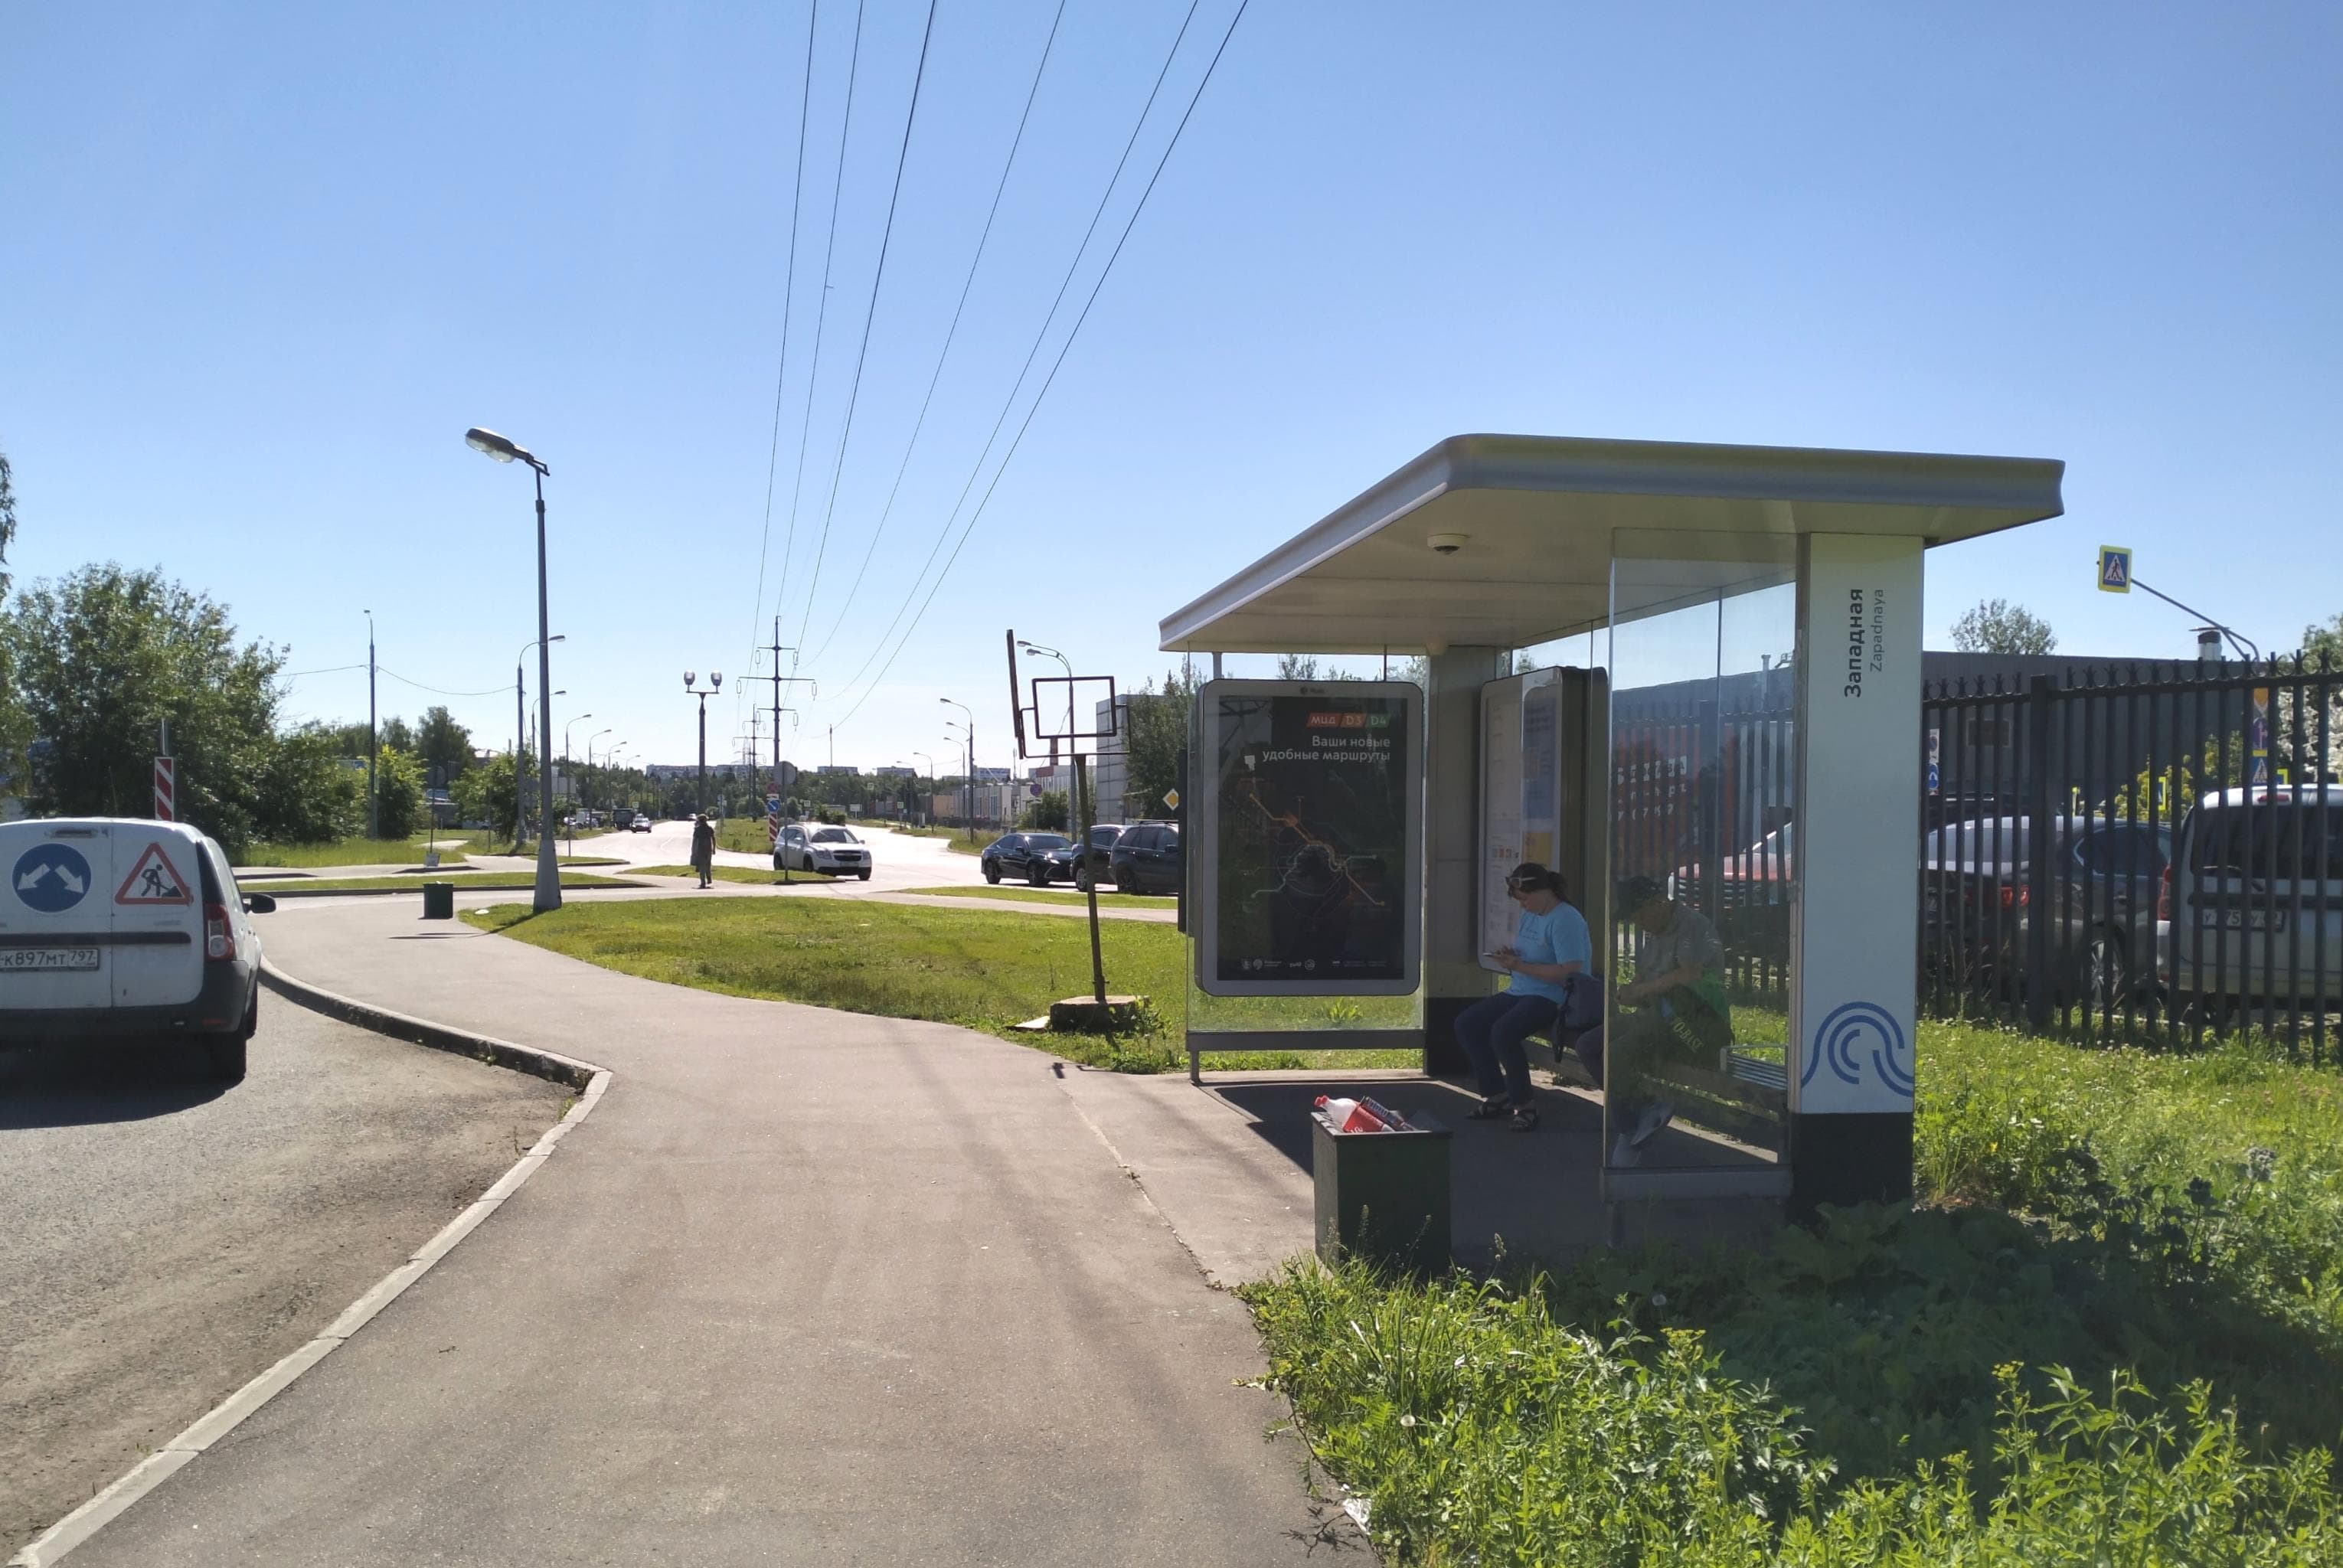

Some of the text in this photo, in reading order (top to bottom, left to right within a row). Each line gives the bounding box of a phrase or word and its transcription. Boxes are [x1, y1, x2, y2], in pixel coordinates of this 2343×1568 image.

[1870, 589, 1885, 672] Zapadnaya
[1844, 589, 1864, 697] Западная
[1371, 716, 1387, 725] D4
[1312, 735, 1390, 747] Ваши новые
[1263, 749, 1390, 763] удобные маршруты
[70, 950, 93, 962] 797
